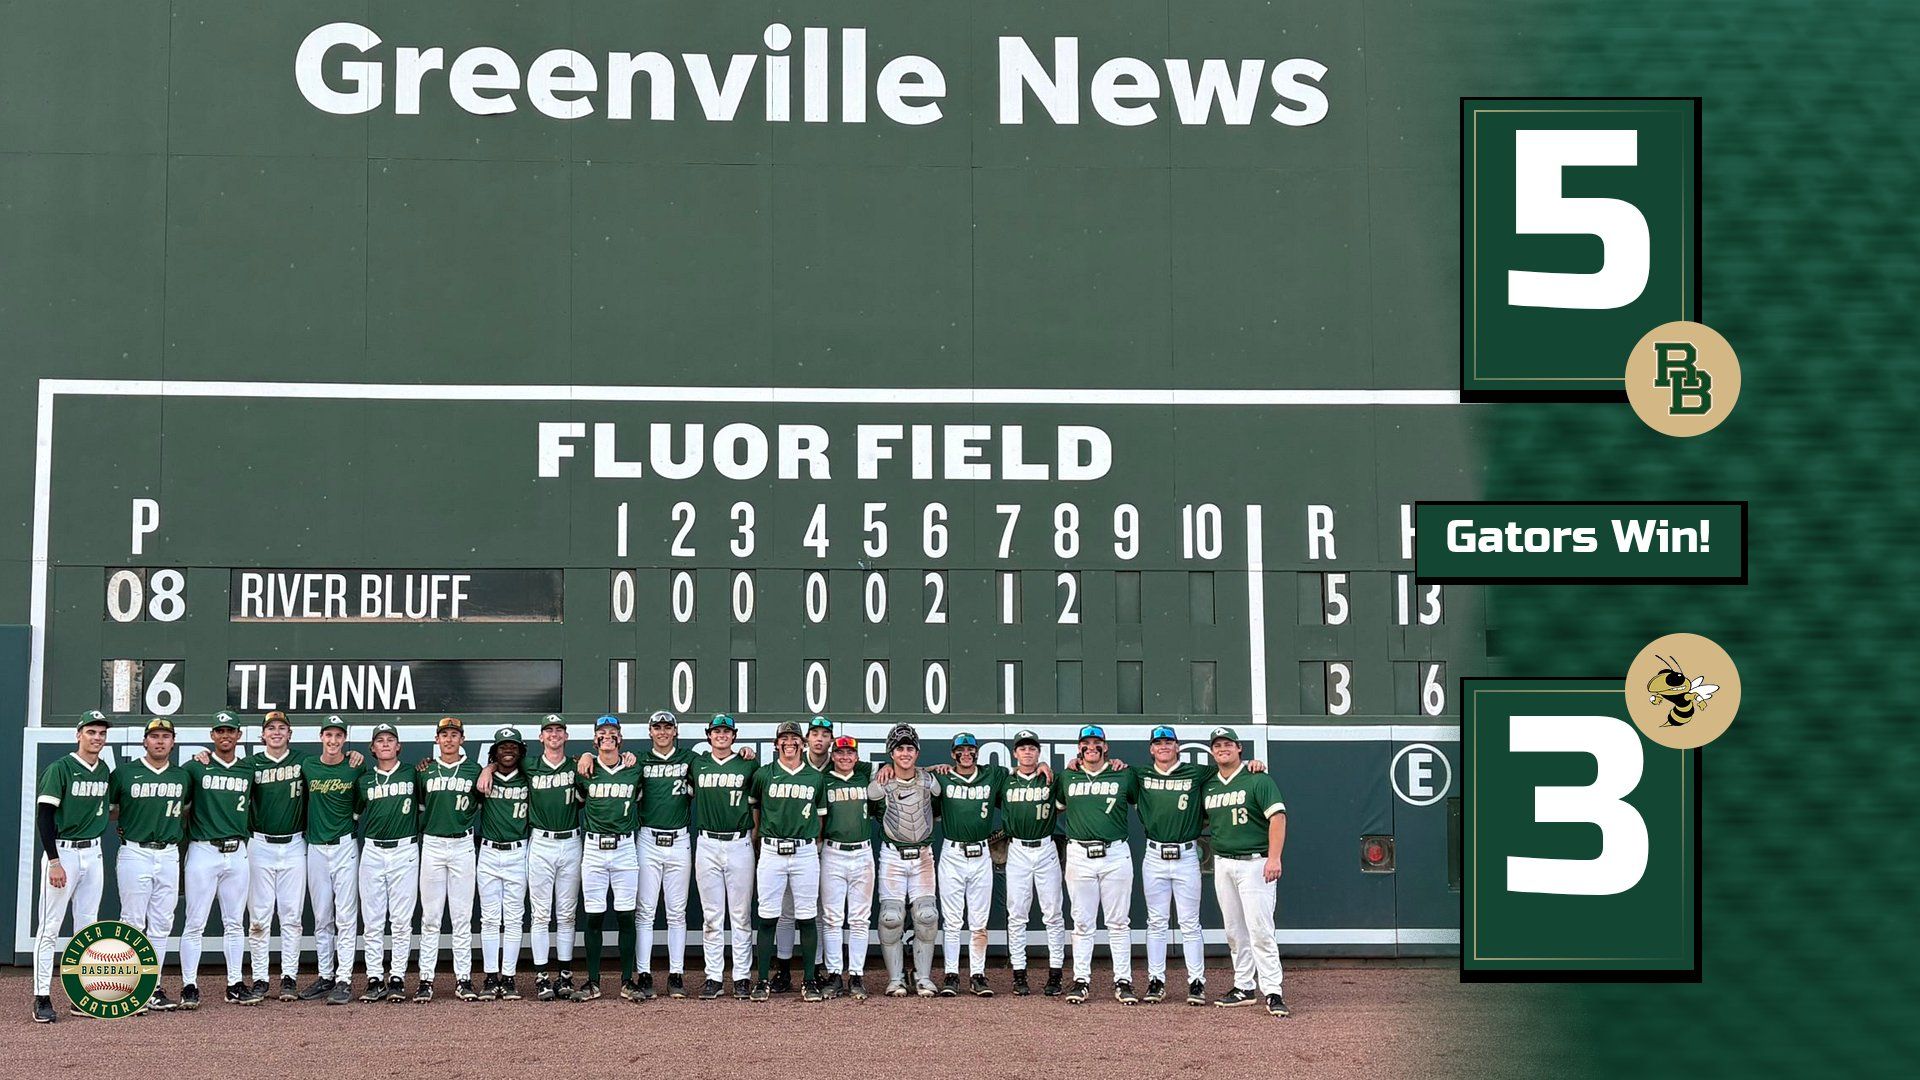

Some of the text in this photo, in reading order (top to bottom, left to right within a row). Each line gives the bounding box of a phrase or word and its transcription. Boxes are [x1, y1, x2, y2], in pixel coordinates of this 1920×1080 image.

[294, 22, 1329, 127] Greenville News
[538, 422, 1112, 481] FLUOR FIELD
[131, 499, 160, 555] P
[617, 502, 628, 557] 1
[671, 502, 696, 557] 2
[730, 502, 755, 558] 3
[803, 503, 830, 558] 4
[863, 503, 888, 558] 5
[922, 503, 948, 559] 6
[995, 504, 1021, 559] 7
[1053, 503, 1080, 559] 8
[1113, 503, 1139, 560] 9
[1182, 504, 1223, 559] 10
[1307, 504, 1337, 560] R
[107, 569, 1441, 626] 08 RIVER BLUFF 0 0 0 0 0 2 1 2 5 13
[235, 664, 277, 710] TL
[289, 664, 416, 710] HANNA
[617, 661, 628, 714] 1
[672, 661, 694, 714] 0
[738, 661, 748, 713] 1
[805, 661, 828, 714] 0
[865, 661, 887, 714] 0
[925, 662, 947, 715] 0
[1004, 663, 1015, 715] 1
[1329, 663, 1352, 716] 3
[1422, 664, 1445, 717] 6
[254, 764, 301, 784] GATORS
[643, 763, 689, 778] GATORS
[1408, 752, 1434, 797] E
[202, 775, 249, 793] GATORS
[426, 777, 473, 793] GATORS
[531, 771, 575, 790] GATORS
[698, 773, 745, 789] GATORS
[130, 783, 183, 798] GATORS
[367, 782, 414, 801] GATORS
[486, 785, 529, 800] ATORS
[588, 784, 634, 798] GATORS
[768, 784, 816, 800] GATORS
[946, 784, 991, 800] GATORS
[1006, 787, 1050, 803] GATORS
[1068, 782, 1120, 797] GATORS
[236, 795, 246, 812] 2
[402, 797, 412, 815] 8
[455, 795, 470, 811] 10
[729, 792, 743, 807] 17
[1104, 797, 1117, 815] 7
[1177, 794, 1189, 811] 6
[1204, 790, 1247, 810] GATORS
[165, 800, 182, 818] 14
[512, 802, 528, 819] 18
[623, 801, 631, 817] 1
[801, 803, 812, 820] 4
[980, 802, 989, 820] 5
[1035, 803, 1050, 821] 16
[1230, 808, 1249, 826] 13
